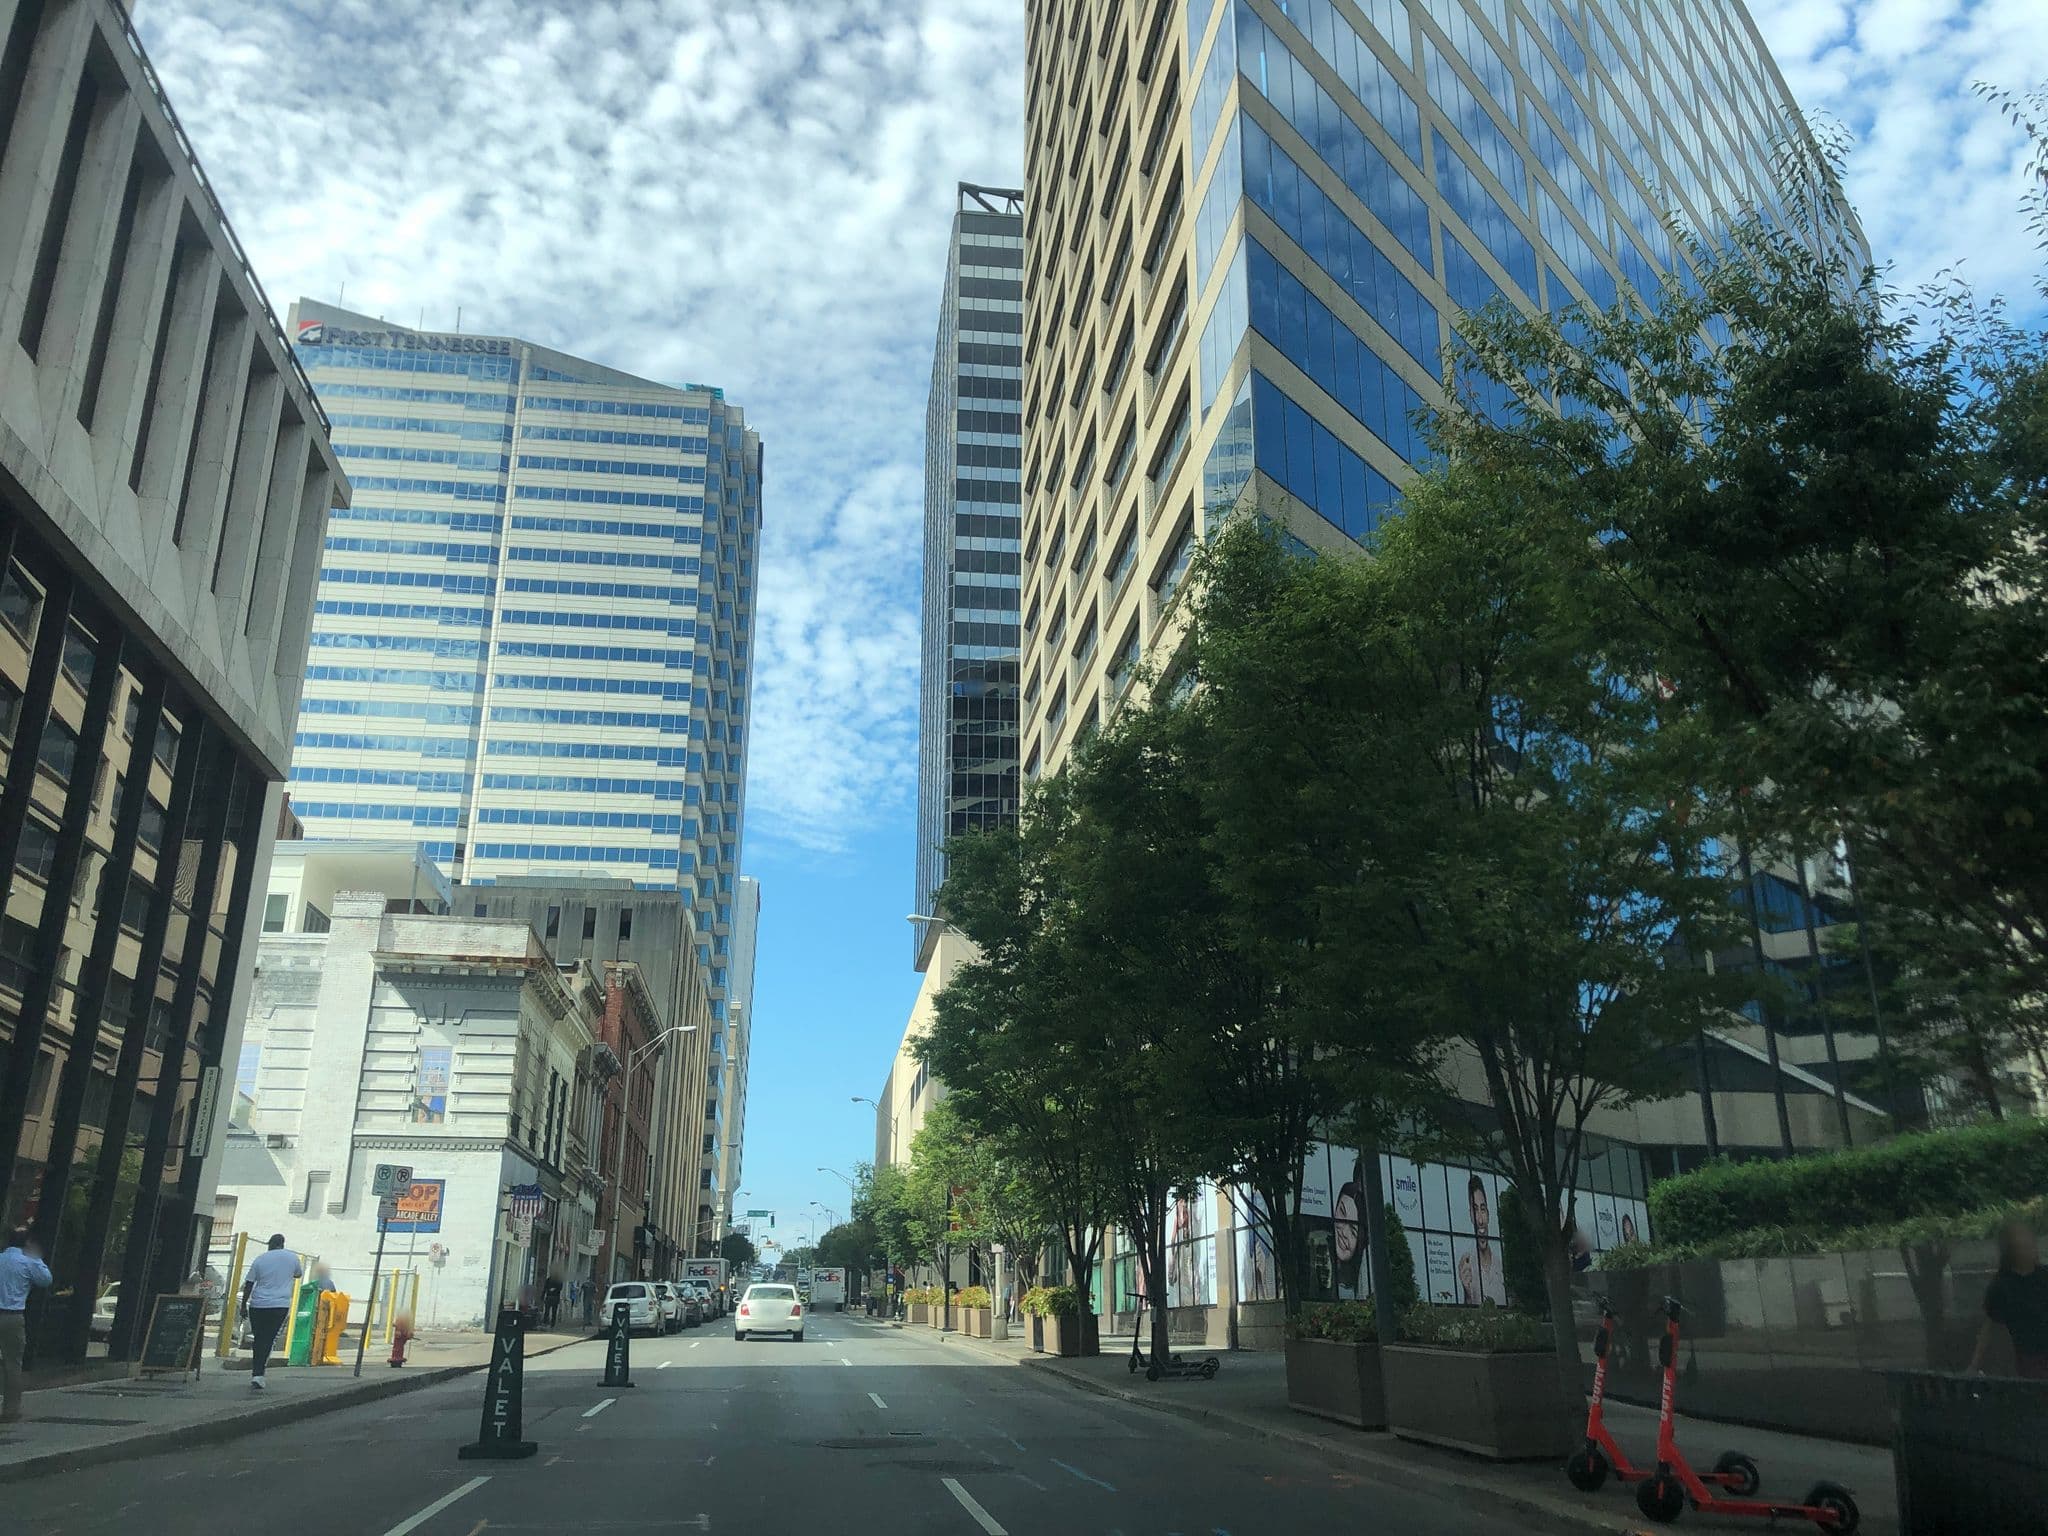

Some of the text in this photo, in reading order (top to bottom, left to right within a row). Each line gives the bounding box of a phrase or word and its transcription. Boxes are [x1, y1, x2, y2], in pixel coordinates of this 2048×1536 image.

[325, 326, 511, 356] FIRST TENNESSEE
[1395, 1176, 1416, 1192] smile
[419, 1212, 439, 1222] ALLEY
[688, 1266, 719, 1276] FedEx
[815, 1271, 841, 1282] FedEx
[613, 1319, 626, 1377] VALET
[493, 1337, 516, 1438] VALET
